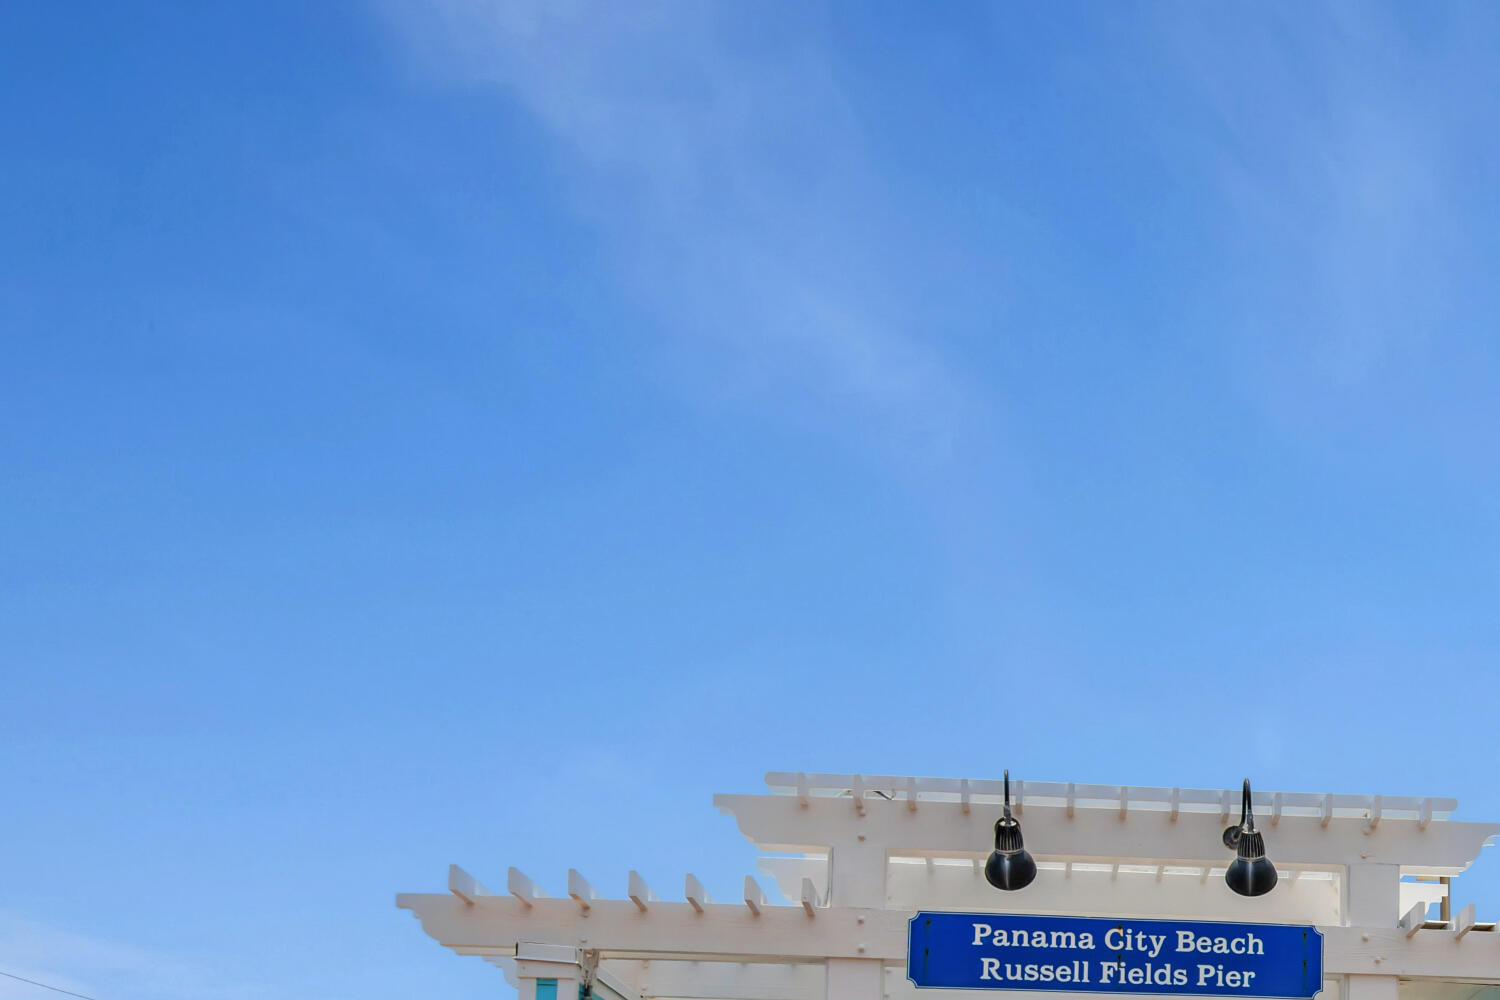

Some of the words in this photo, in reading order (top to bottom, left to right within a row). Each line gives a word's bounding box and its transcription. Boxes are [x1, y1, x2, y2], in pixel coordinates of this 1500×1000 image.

[972, 923, 1095, 949] Panama
[1105, 928, 1166, 957] City
[1176, 930, 1264, 955] Beach
[980, 957, 1090, 983] Russell
[1100, 961, 1187, 987] Fields
[1197, 964, 1256, 987] Pier
